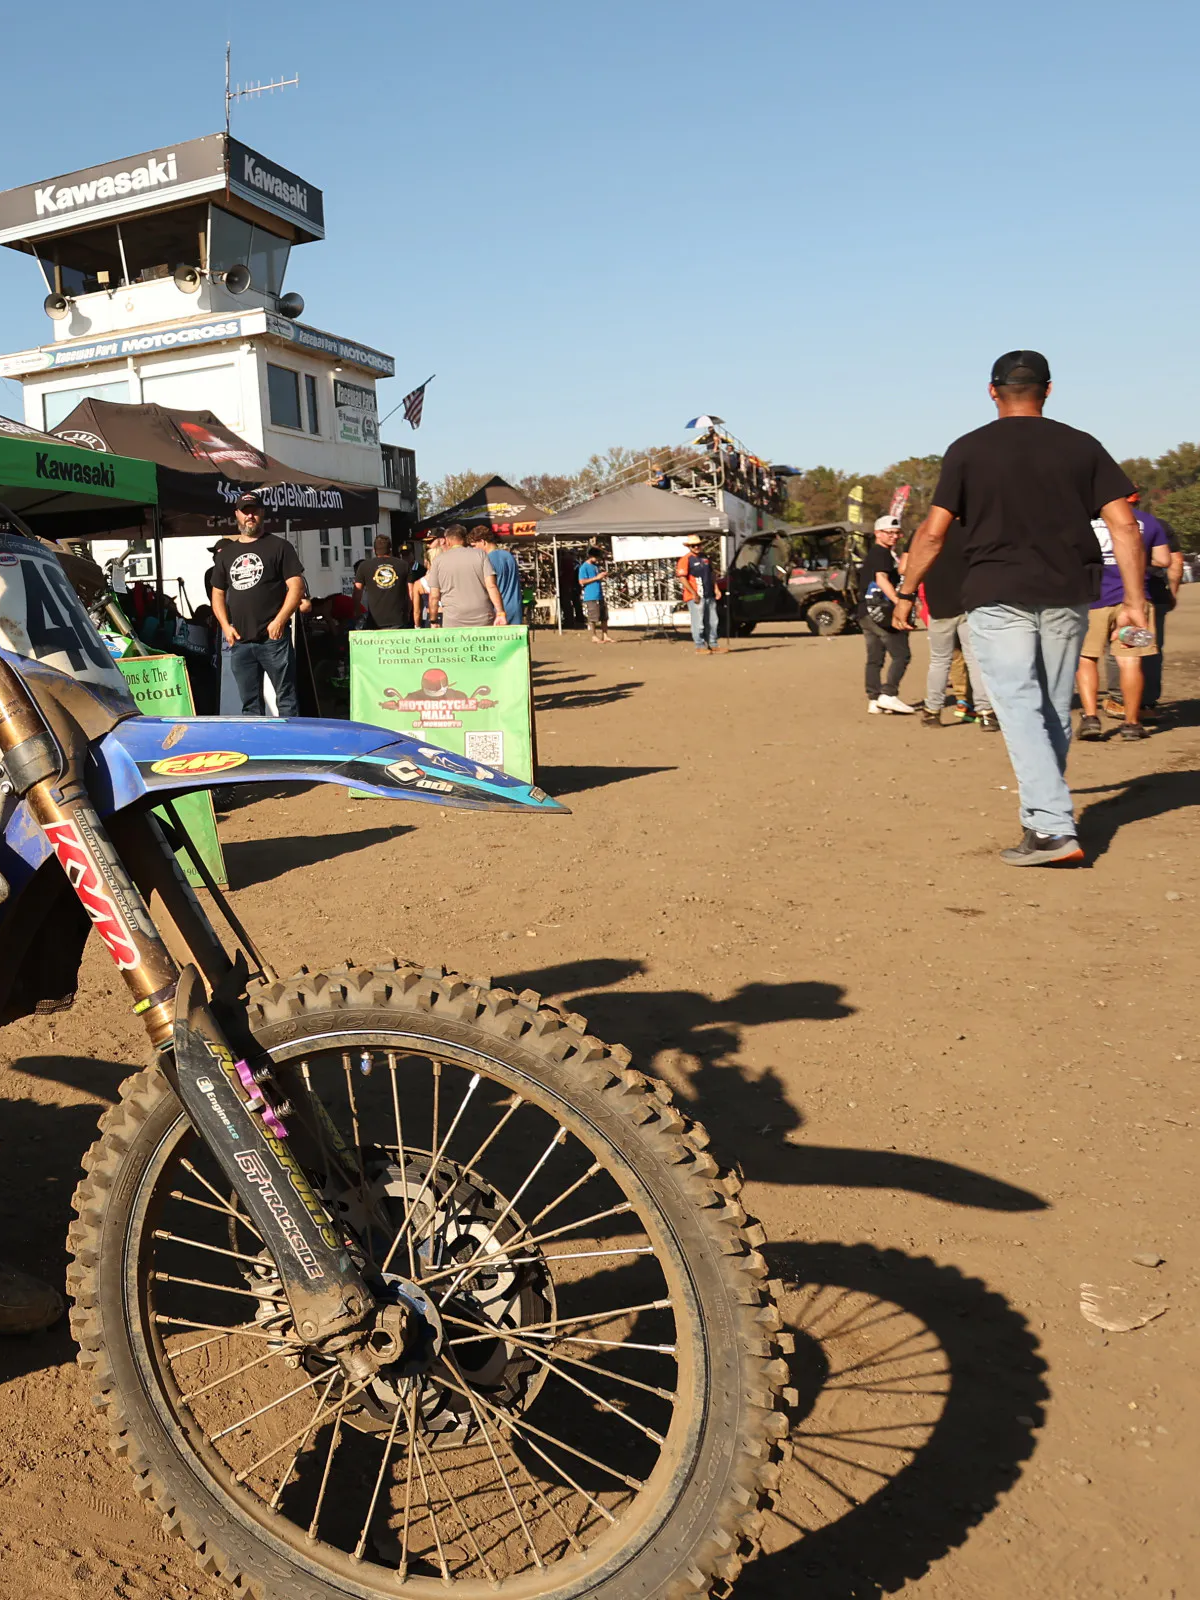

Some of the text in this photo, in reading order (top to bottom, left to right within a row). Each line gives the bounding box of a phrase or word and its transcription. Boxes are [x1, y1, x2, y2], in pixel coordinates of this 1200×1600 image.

[34, 153, 178, 215] Kawasaki
[244, 154, 308, 212] Kawasaki
[55, 322, 238, 364] Raceway Park MOTOCROSS
[300, 330, 394, 373] Raceway Park MOTOCROSS
[337, 383, 375, 412] Raceway Park
[36, 452, 115, 489] Kawasaki
[353, 632, 522, 647] Motorcycle Mall of Monmouth
[378, 643, 496, 656] Proud Sponsor of the
[378, 654, 497, 665] Ironman Classic Race
[142, 667, 168, 682] & The
[398, 700, 477, 710] MOTORCYCLE
[420, 710, 454, 720] MALL
[154, 752, 248, 773] FMF
[416, 780, 454, 793] odi
[258, 1182, 325, 1280] TRACKSIDE
